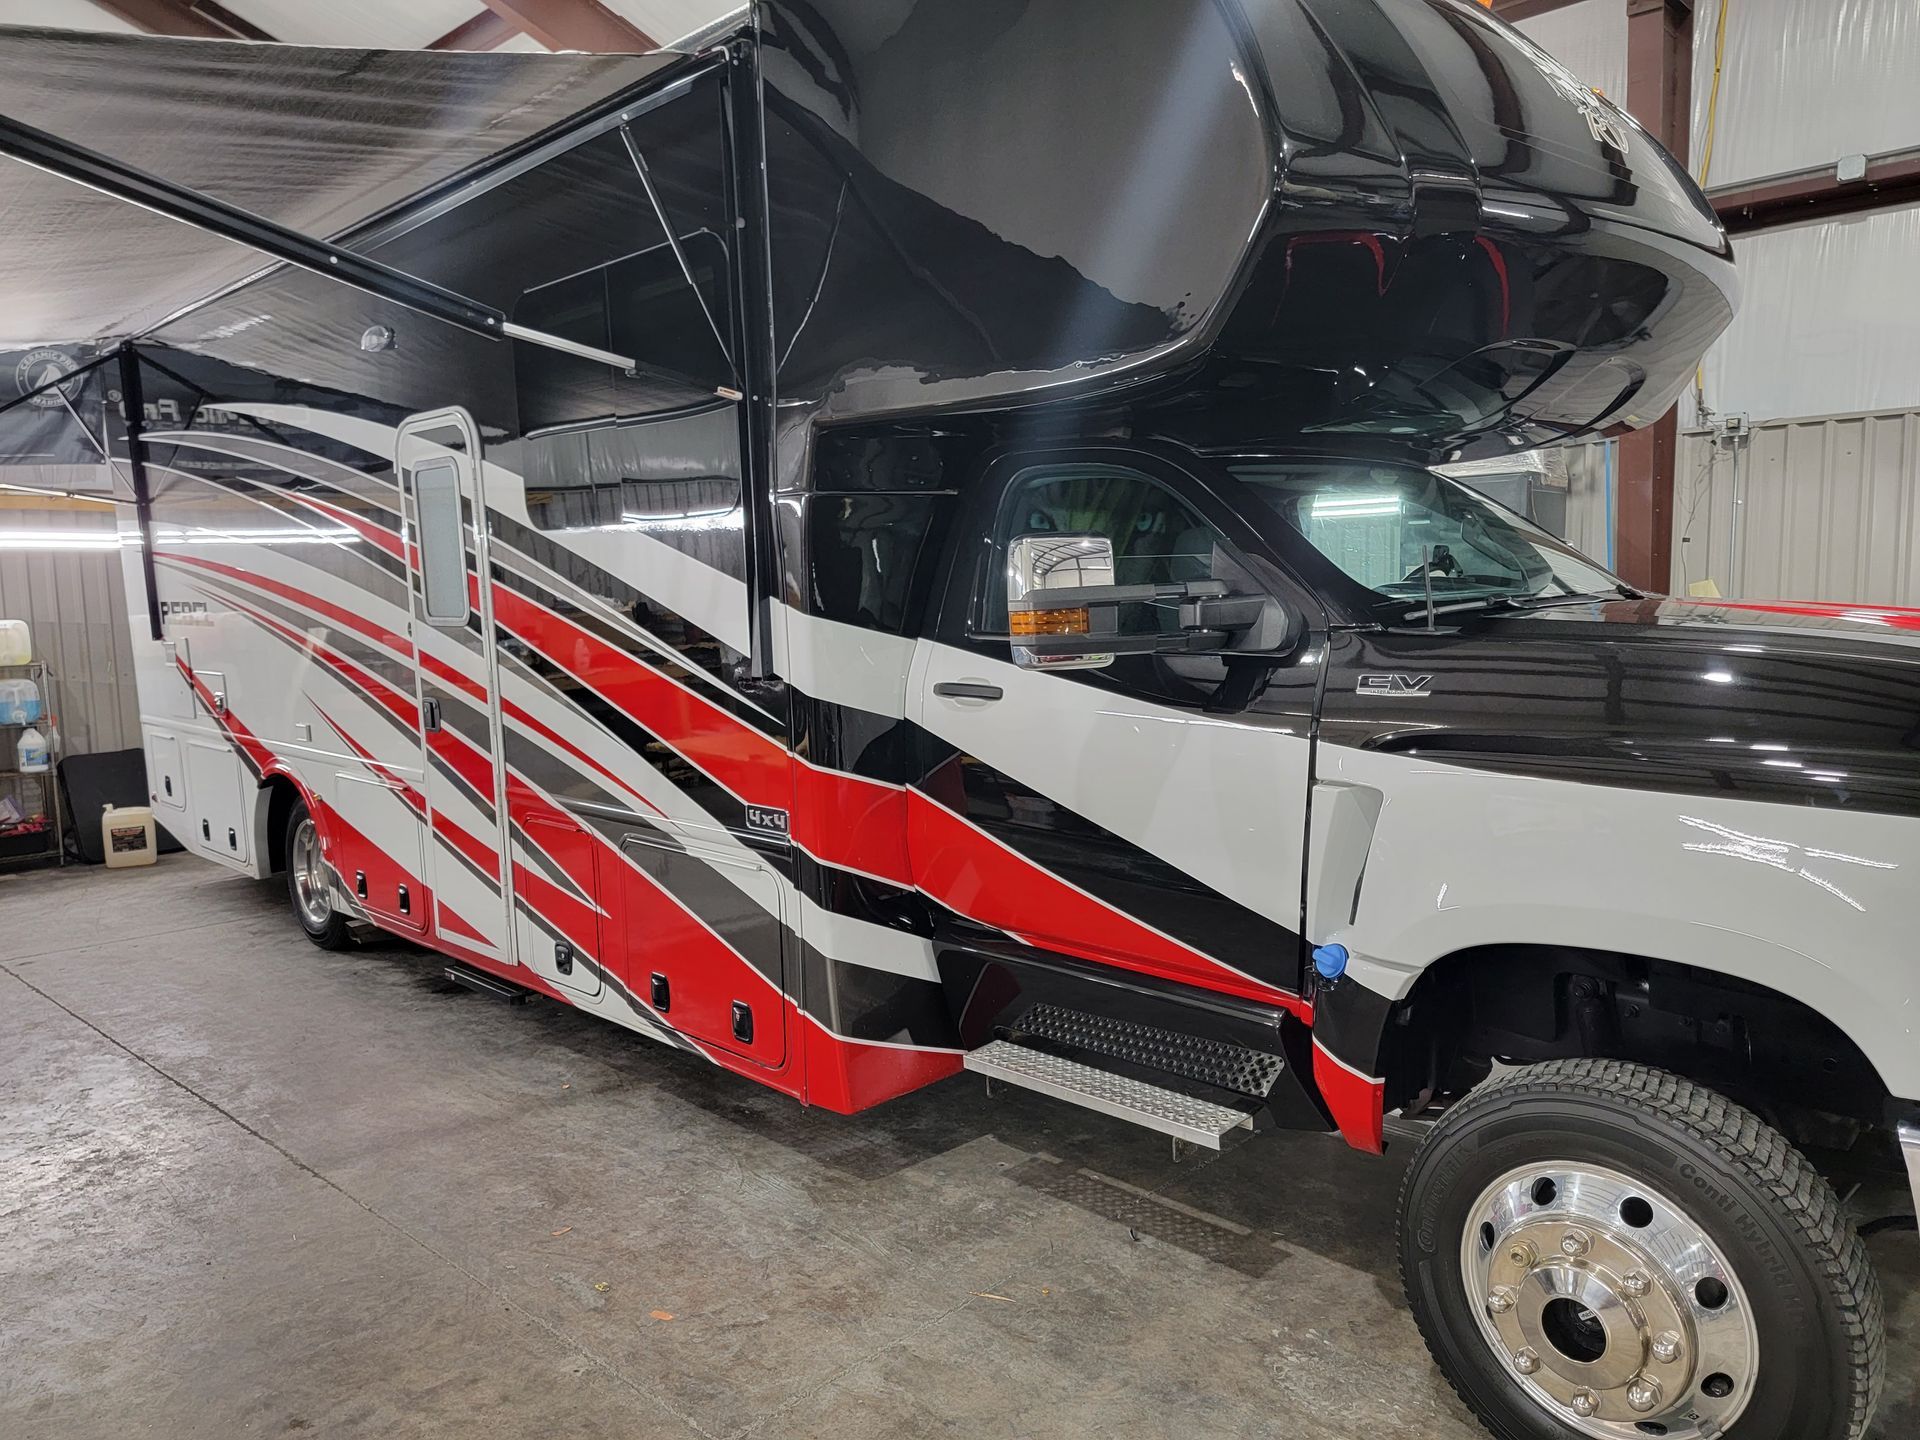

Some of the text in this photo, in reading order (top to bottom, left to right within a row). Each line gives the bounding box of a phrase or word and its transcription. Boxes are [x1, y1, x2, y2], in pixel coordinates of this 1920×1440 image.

[748, 809, 786, 829] 4x4
[1678, 1162, 1796, 1289] Conti Hybrid
